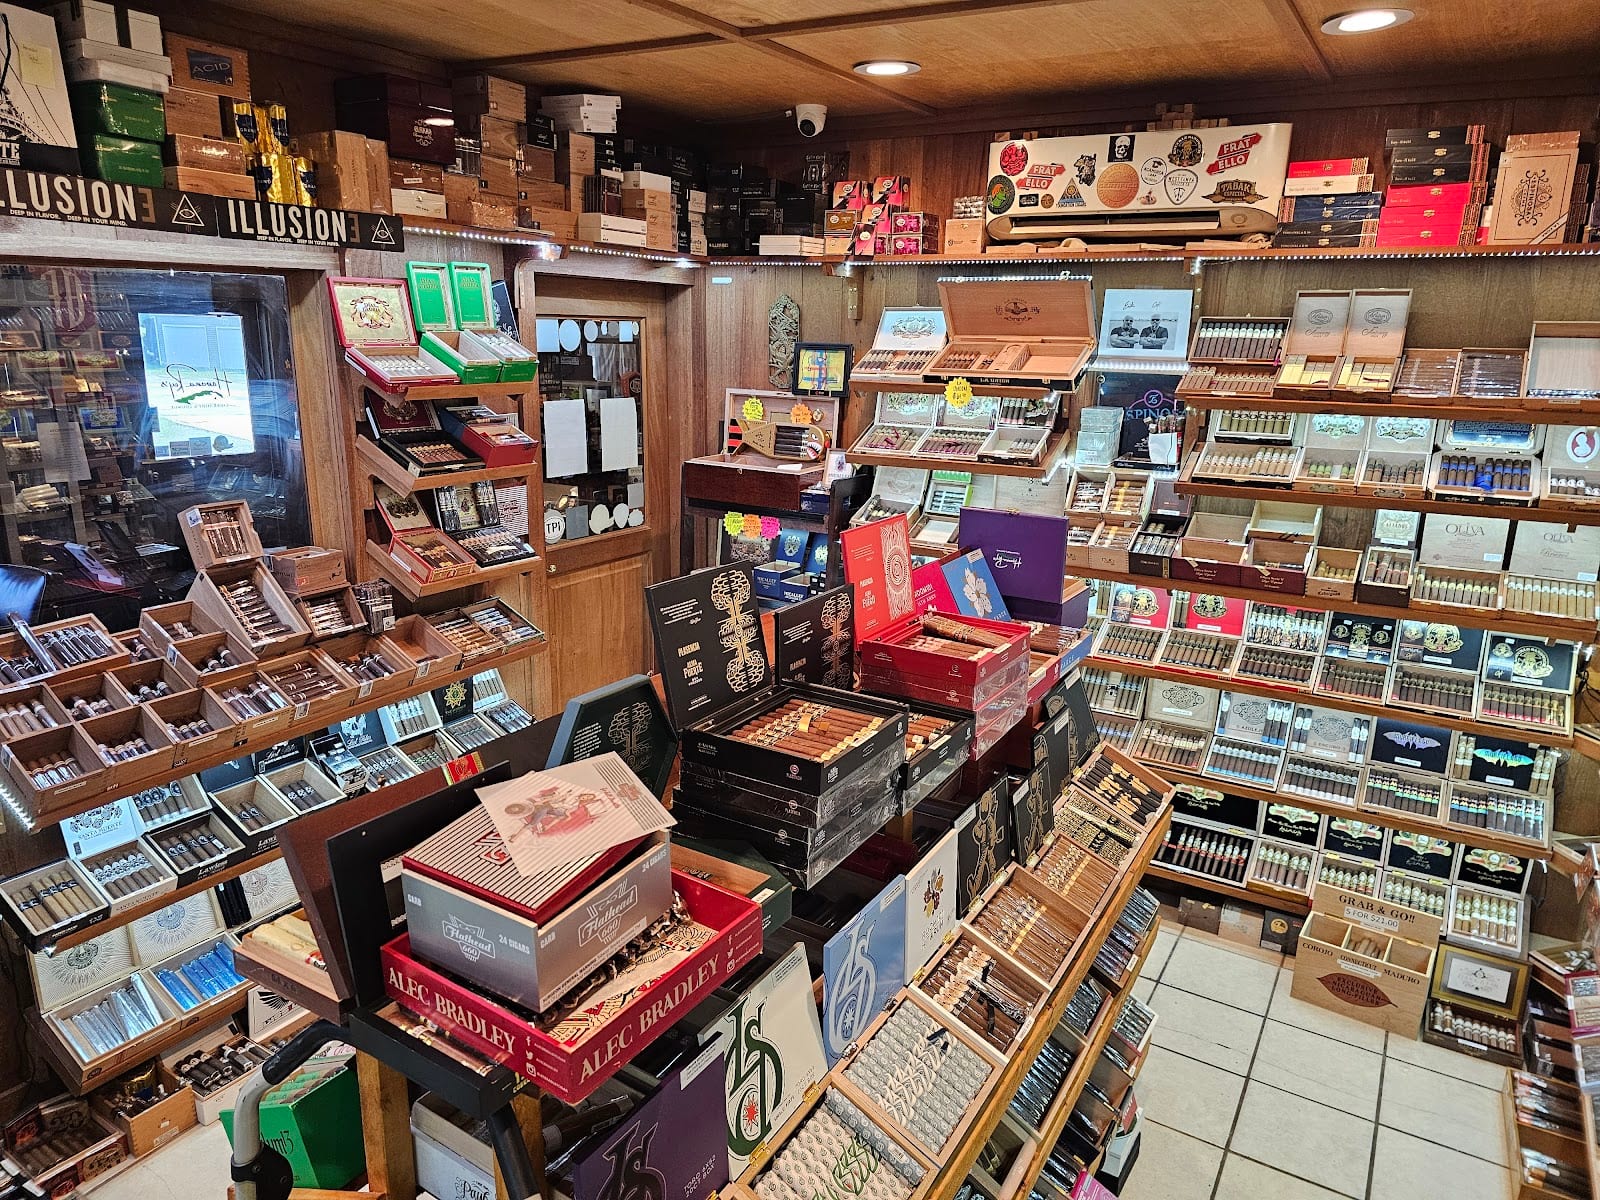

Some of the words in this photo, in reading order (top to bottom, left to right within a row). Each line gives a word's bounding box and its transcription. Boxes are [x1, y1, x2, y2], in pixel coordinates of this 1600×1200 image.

[192, 62, 231, 74] ACID
[1222, 138, 1252, 154] FRAT
[1032, 164, 1057, 176] FRAT
[1217, 155, 1246, 170] ELLO
[1025, 177, 1049, 189] ELLO
[1220, 182, 1252, 193] TABAK
[0, 169, 156, 224] LUSIONE
[10, 208, 26, 216] DEEP
[67, 215, 82, 223] DEEP
[91, 217, 109, 225] YOUR
[109, 219, 129, 227] MIND.
[642, 862, 650, 873] 24
[649, 848, 667, 867] CIGARS
[407, 893, 423, 907] CARB
[1338, 894, 1374, 911] GRAB
[1377, 906, 1386, 915] &
[1390, 909, 1416, 924] GO!!
[582, 890, 634, 940] Flathead
[1352, 910, 1369, 921] FOR
[1371, 914, 1398, 928] $21.00
[601, 920, 619, 938] 660
[444, 926, 493, 953] Flathead
[499, 934, 508, 945] 24
[508, 938, 531, 955] CIGARS
[540, 931, 556, 949] CARB
[462, 944, 478, 957] 660
[1302, 942, 1334, 957] COROJO
[1383, 968, 1421, 985] MADURO
[389, 966, 432, 1008] ALEC
[435, 990, 516, 1055] BRADLEY
[579, 1023, 633, 1085] ALEC
[639, 953, 720, 1035] BRADLEY
